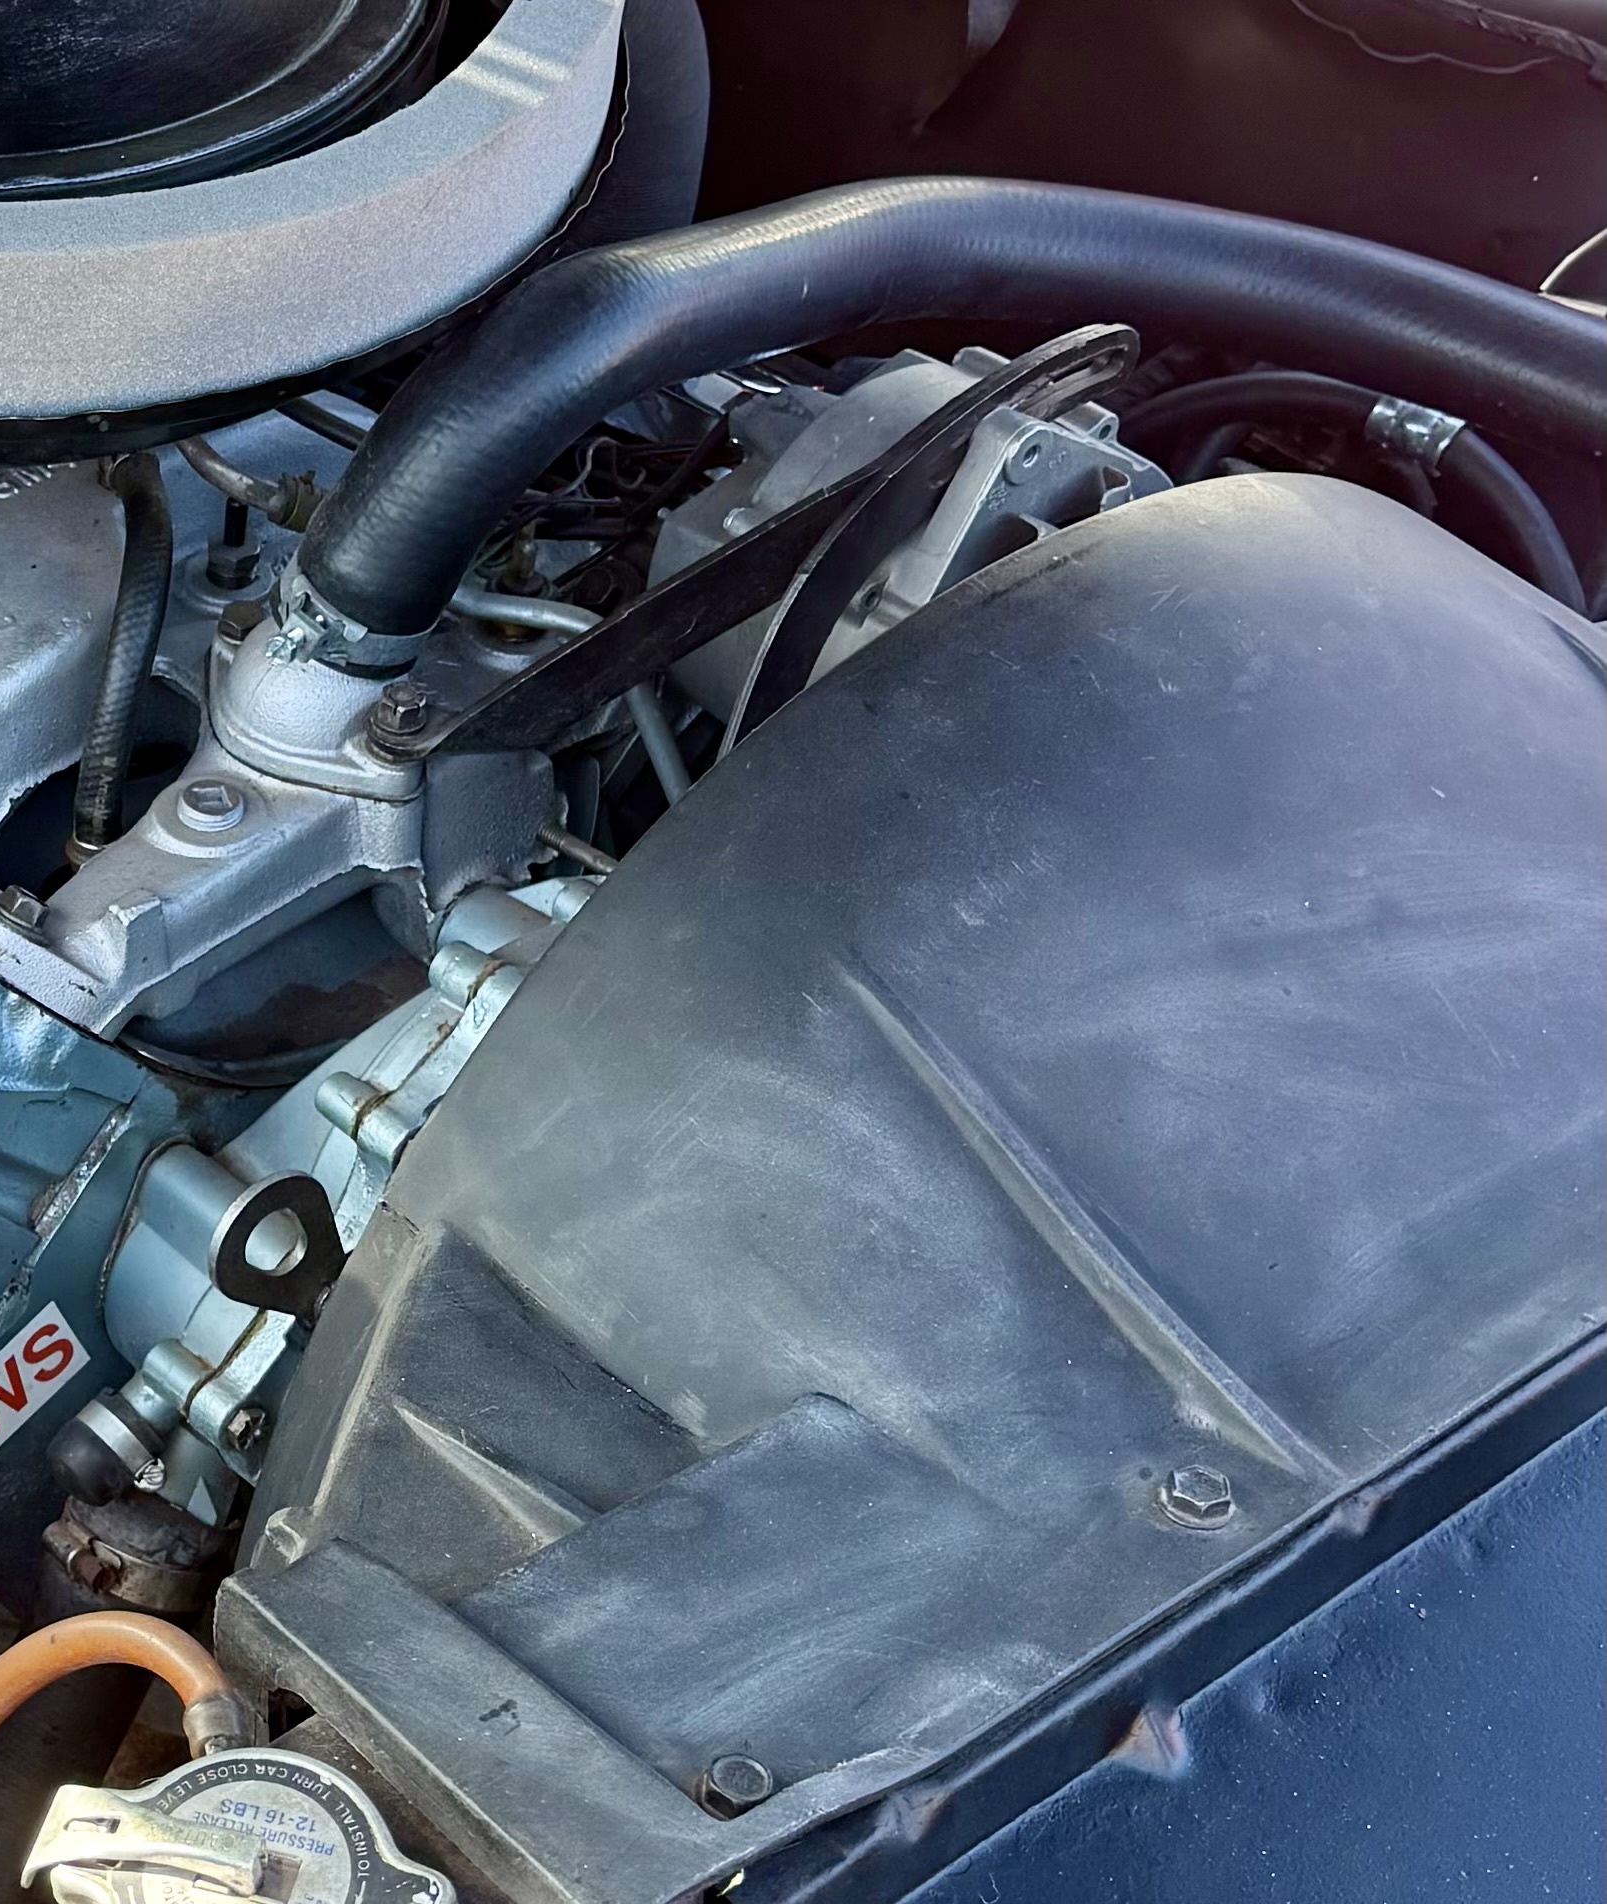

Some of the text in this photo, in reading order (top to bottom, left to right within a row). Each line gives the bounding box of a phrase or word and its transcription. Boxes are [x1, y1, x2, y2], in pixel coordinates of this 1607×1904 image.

[196, 1762, 248, 1785] CLOSE
[291, 1773, 331, 1800] TURN
[220, 1798, 316, 1833] 12-16 LBS
[334, 1800, 368, 1858] INSTALL
[255, 1827, 336, 1856] PRESSURE
